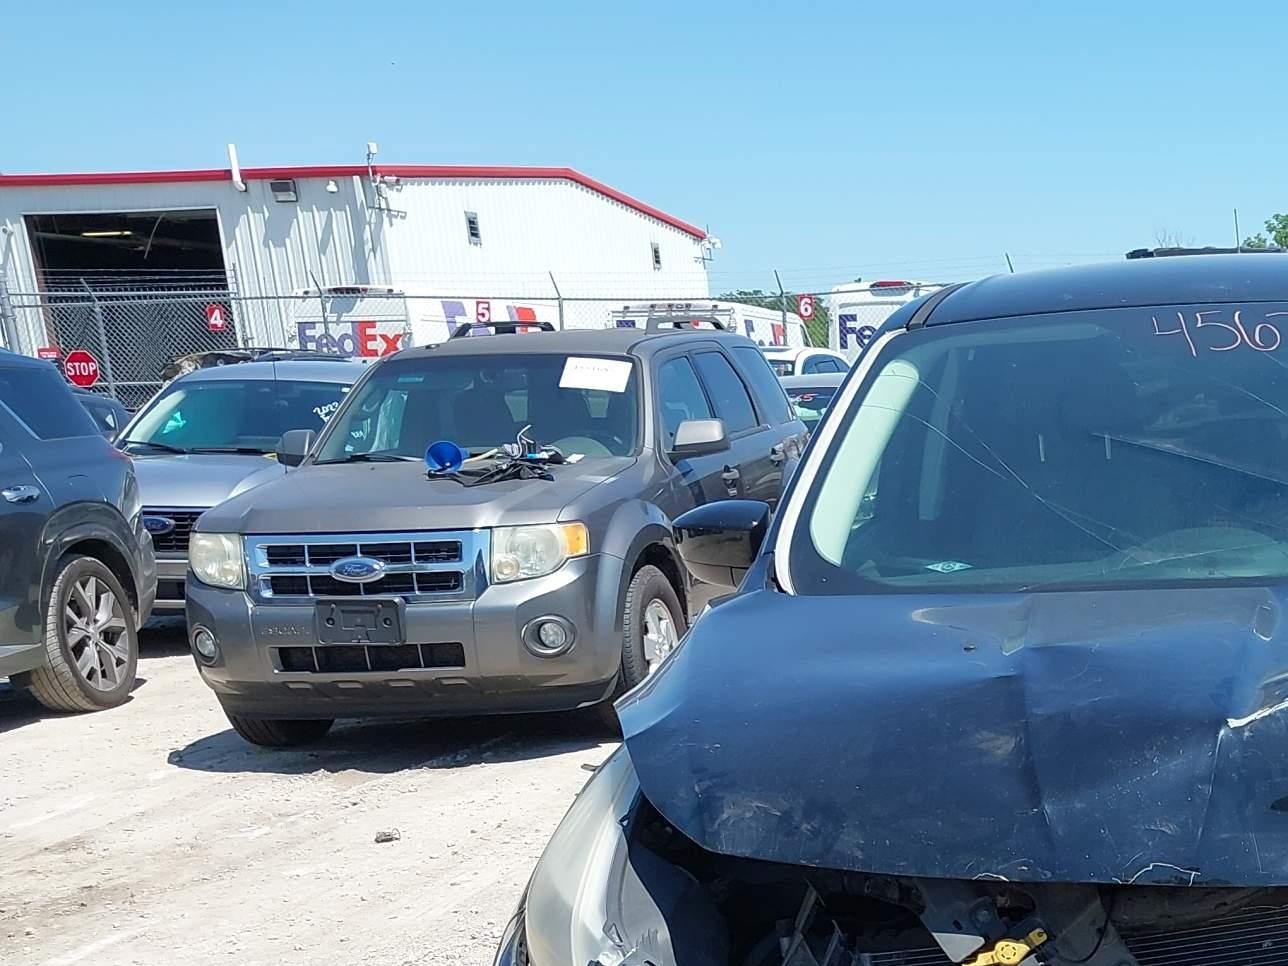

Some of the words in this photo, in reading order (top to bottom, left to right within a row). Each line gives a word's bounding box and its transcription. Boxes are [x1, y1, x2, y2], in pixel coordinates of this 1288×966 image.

[477, 303, 490, 322] 5
[799, 298, 812, 317] 6
[210, 308, 224, 328] 4
[297, 320, 403, 358] FedEx
[66, 361, 97, 376] STOP
